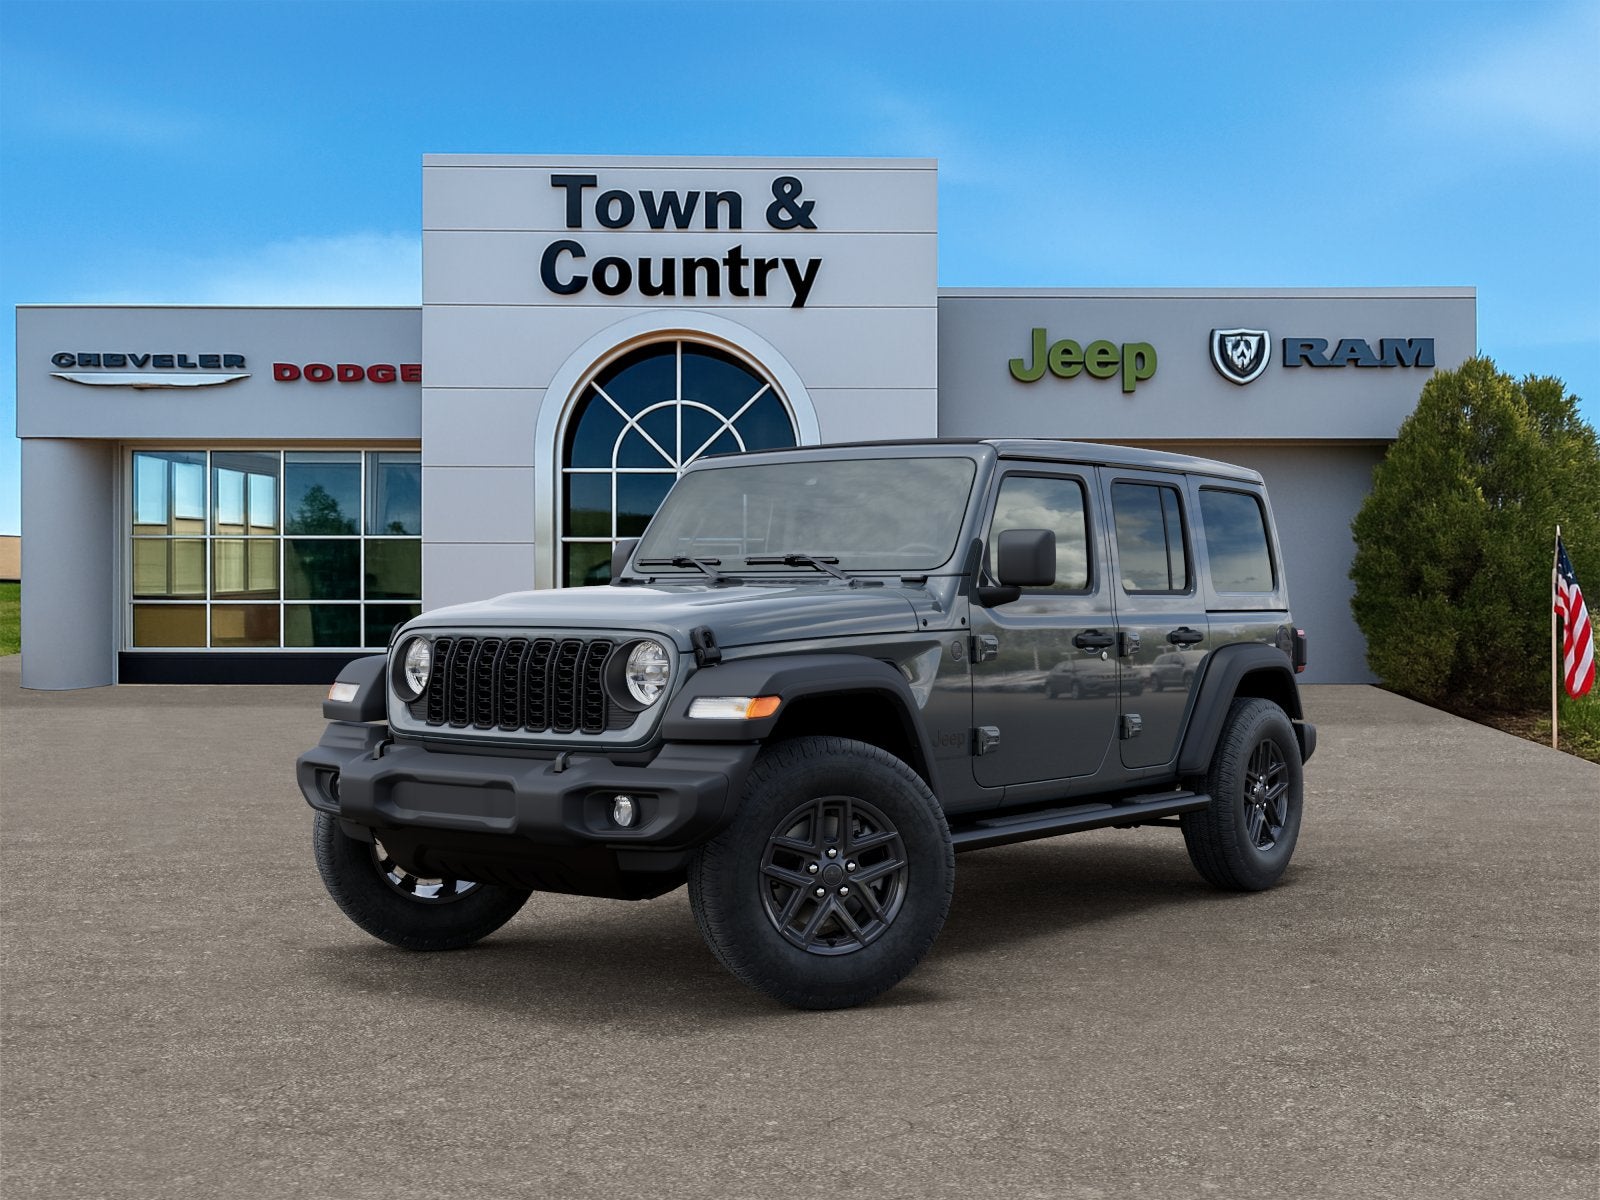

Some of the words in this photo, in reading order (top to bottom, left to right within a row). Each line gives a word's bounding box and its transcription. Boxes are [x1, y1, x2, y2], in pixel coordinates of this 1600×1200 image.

[551, 174, 742, 229] Town
[765, 176, 818, 229] &
[540, 239, 822, 308] Country
[273, 363, 421, 382] DODGE
[1009, 328, 1157, 392] Jeep
[1282, 337, 1435, 367] RAM
[932, 728, 966, 748] Jeep
